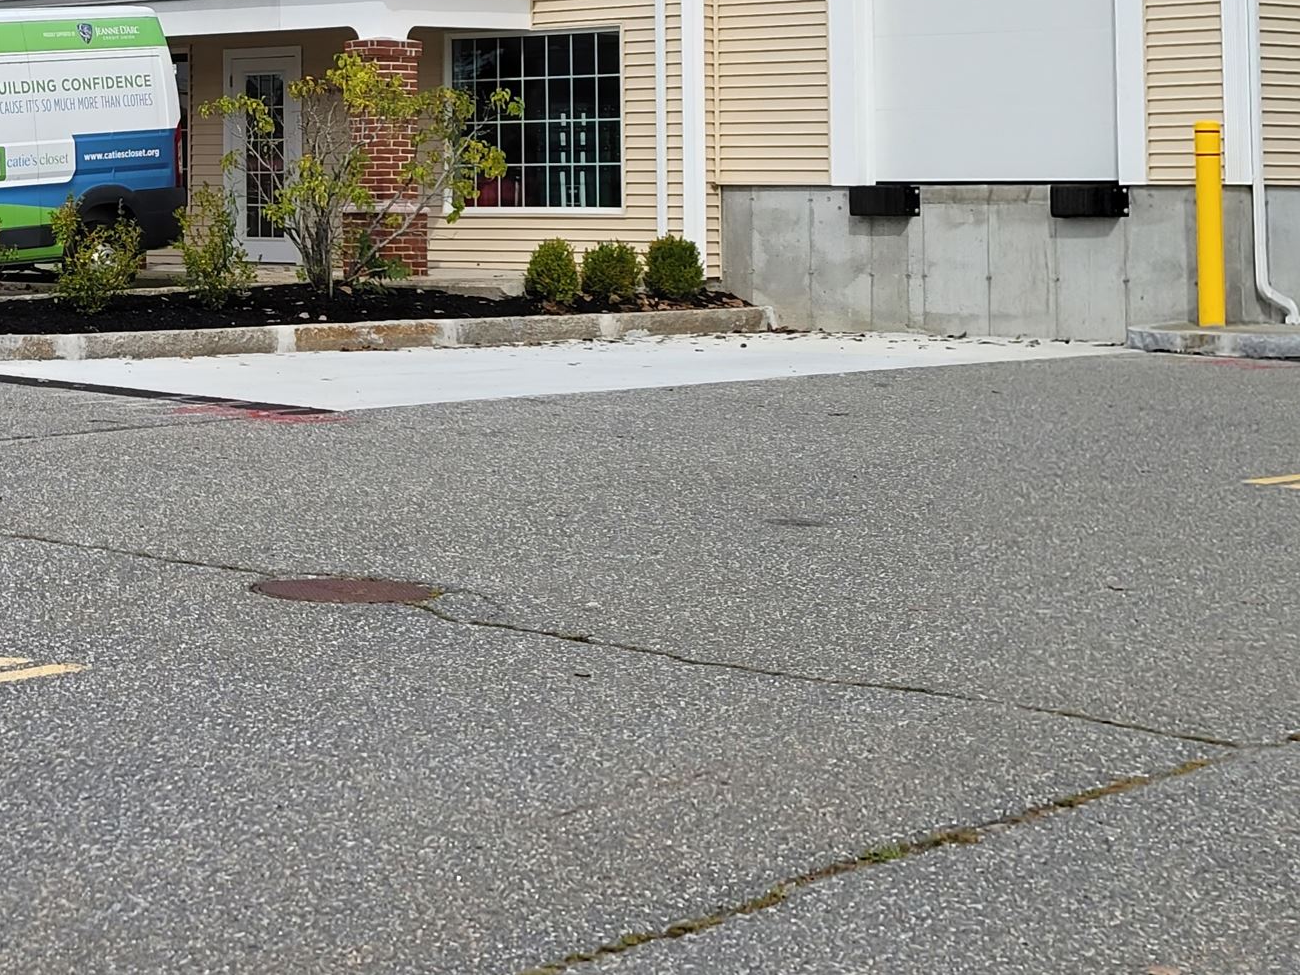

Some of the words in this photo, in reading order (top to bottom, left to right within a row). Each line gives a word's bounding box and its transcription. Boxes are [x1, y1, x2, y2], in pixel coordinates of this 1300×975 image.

[95, 26, 119, 36] JEANNE
[62, 74, 152, 92] CONFIDENCE
[26, 99, 39, 114] IT'S
[42, 98, 53, 113] SO
[54, 97, 76, 112] MUCH
[78, 95, 98, 111] MORE
[101, 94, 121, 109] THAN
[123, 92, 153, 108] CLOTHES
[7, 154, 38, 168] catie's
[40, 152, 69, 166] closet
[83, 149, 160, 162] www.catiescloset.org
